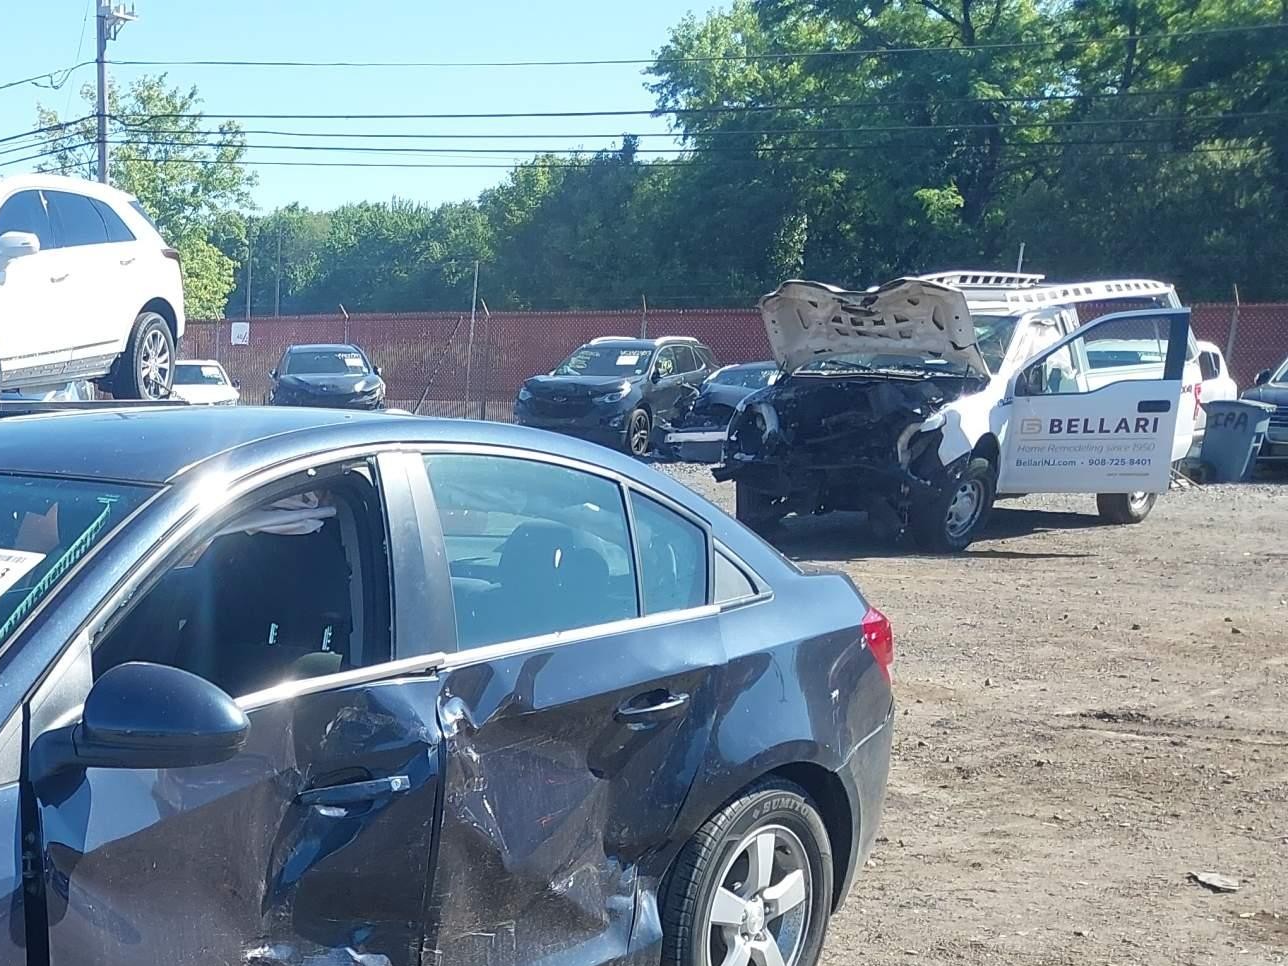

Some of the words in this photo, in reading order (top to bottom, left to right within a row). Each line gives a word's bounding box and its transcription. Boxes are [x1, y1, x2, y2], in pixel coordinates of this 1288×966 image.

[1049, 417, 1159, 434] BELLARI
[1016, 444, 1045, 454] Home
[1047, 443, 1104, 455] Remodeling
[1107, 444, 1130, 453] since
[1132, 442, 1156, 451] 1950
[1015, 458, 1077, 467] BellariNJ.com
[1088, 458, 1152, 467] 908-725-8401
